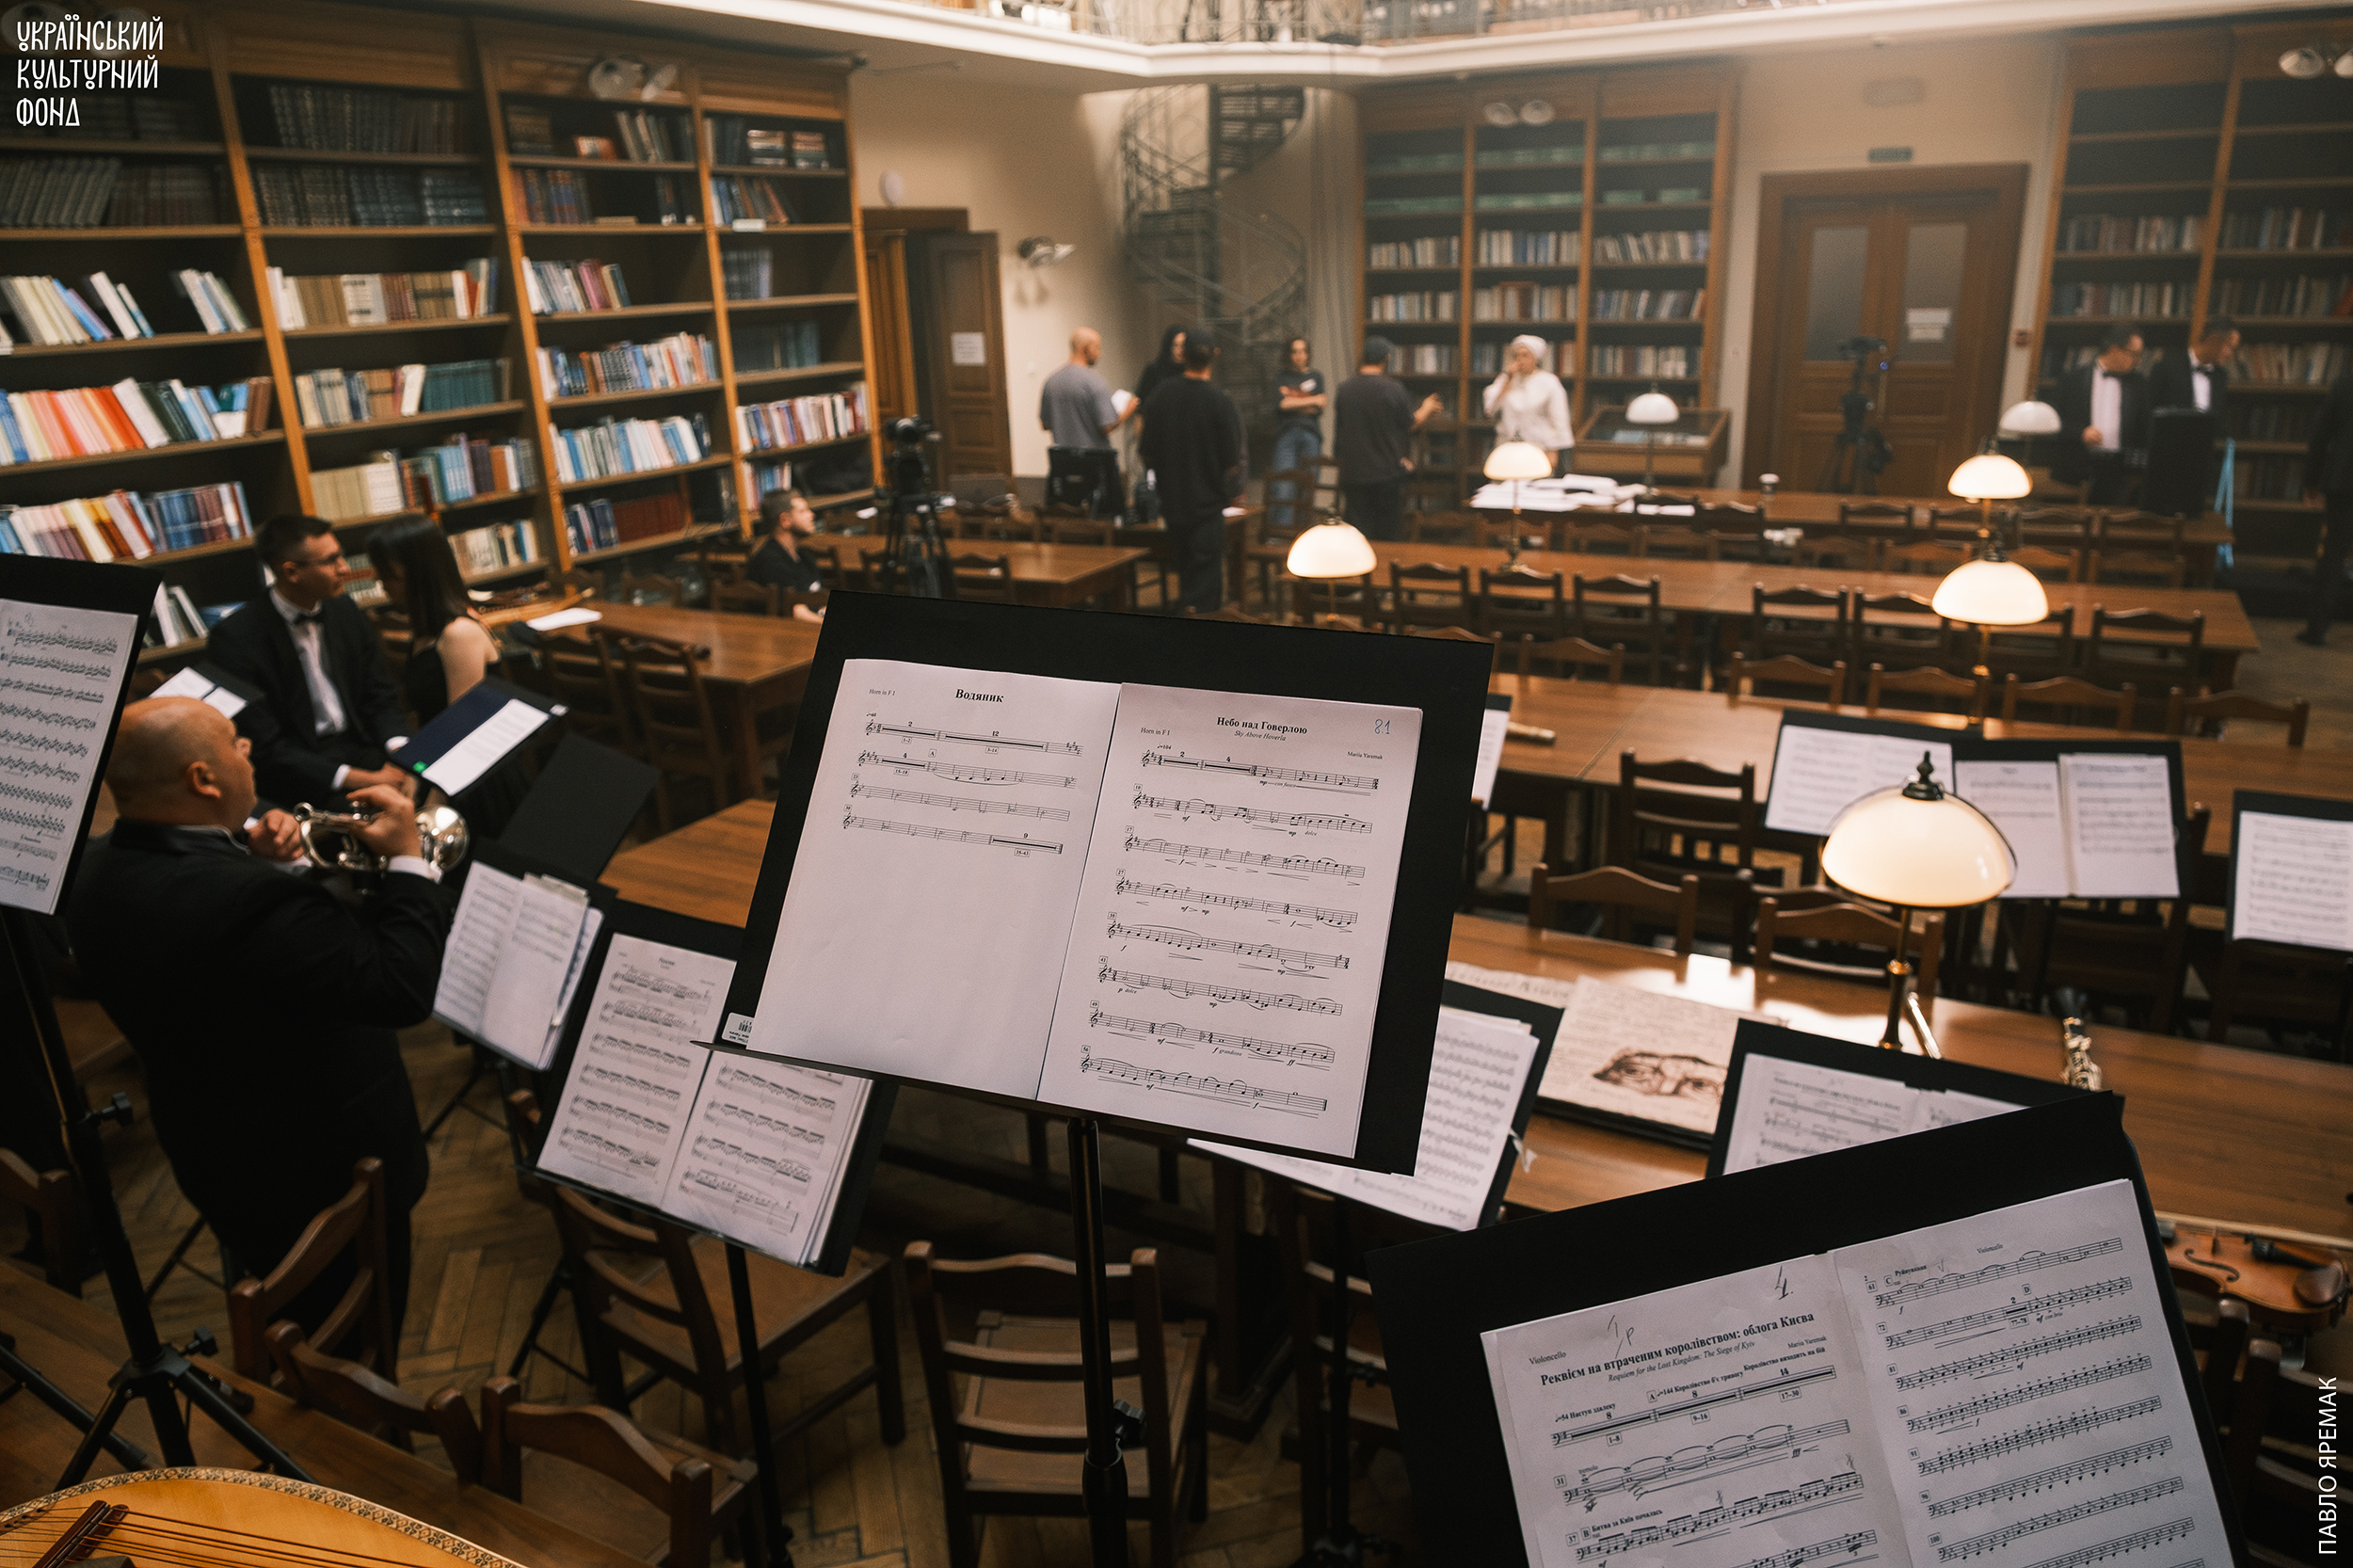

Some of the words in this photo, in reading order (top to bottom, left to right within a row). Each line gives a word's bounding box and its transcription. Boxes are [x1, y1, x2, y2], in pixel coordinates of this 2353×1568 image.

[955, 688, 1004, 703] Водяник
[1140, 727, 1155, 735] Horn
[1217, 716, 1241, 728] Небо
[1241, 721, 1259, 730] над
[1261, 721, 1308, 735] Говерлою
[1234, 729, 1244, 738] Sky
[1245, 730, 1263, 739] Above
[1263, 733, 1287, 742] Hoverla
[1541, 1368, 1586, 1386] Реквієм
[1588, 1365, 1602, 1375] на
[1604, 1349, 1663, 1371] втраченим
[1665, 1331, 1741, 1356] королівством:
[1742, 1322, 1778, 1337] облога
[1780, 1313, 1815, 1328] Києва
[1529, 1351, 1567, 1365] Violoncello
[1608, 1370, 1635, 1383] Requiem
[1636, 1367, 1645, 1375] for
[1657, 1360, 1672, 1370] Lost
[1673, 1352, 1703, 1366] Kingdom:
[1704, 1350, 1716, 1359] The
[1716, 1346, 1734, 1356] Siege
[1734, 1343, 1742, 1352] of
[1741, 1340, 1756, 1352] Kyiv
[1743, 1358, 1780, 1372] Королівство
[1673, 1379, 1711, 1394] Королівство
[1692, 1390, 1699, 1399] 8
[1569, 1408, 1593, 1419] Наступ
[1606, 1412, 1612, 1420] 8
[1592, 1523, 1611, 1533] Битва
